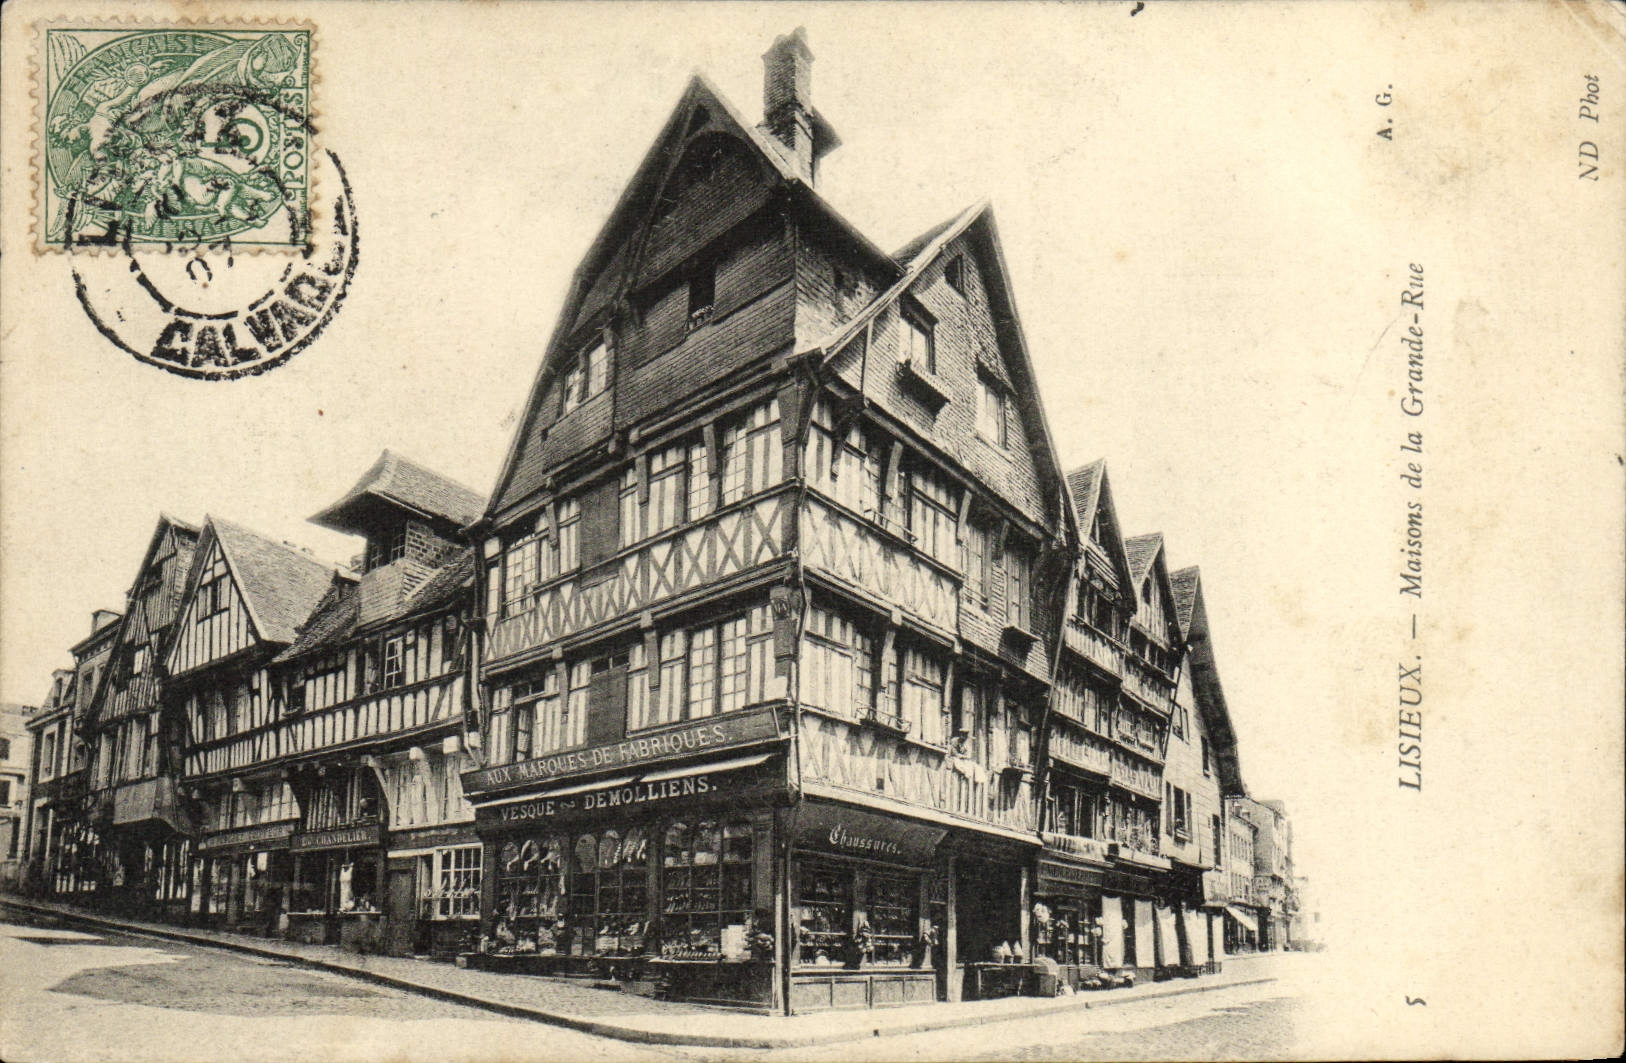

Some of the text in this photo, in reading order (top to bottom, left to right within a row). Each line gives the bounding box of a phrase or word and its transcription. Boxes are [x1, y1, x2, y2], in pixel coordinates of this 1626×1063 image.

[282, 91, 306, 185] POSTES
[487, 724, 734, 786] AUX MARQUES DE FABRIQUES.
[501, 776, 717, 821] VESQUE DEMOLLIENS.
[828, 823, 902, 855] Chaussures.
